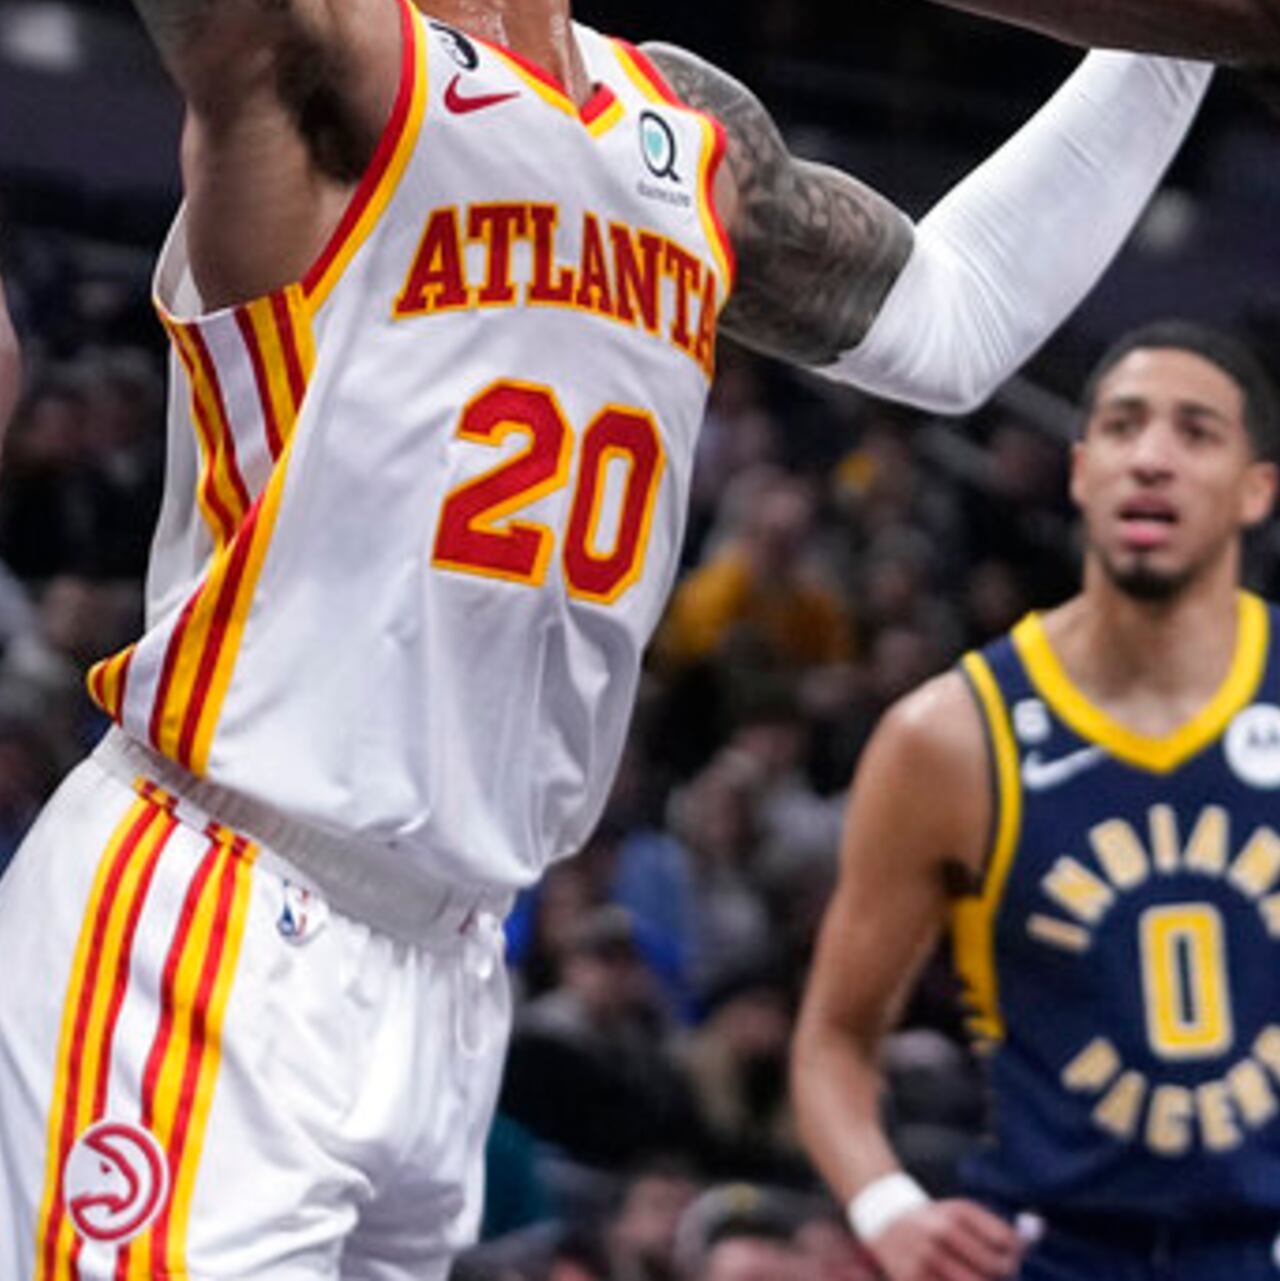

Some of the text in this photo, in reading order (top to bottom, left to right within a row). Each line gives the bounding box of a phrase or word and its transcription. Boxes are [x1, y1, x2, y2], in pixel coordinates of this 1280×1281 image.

[389, 198, 718, 386] ATLANTA
[430, 376, 667, 607] 20
[1137, 900, 1234, 1062] 0
